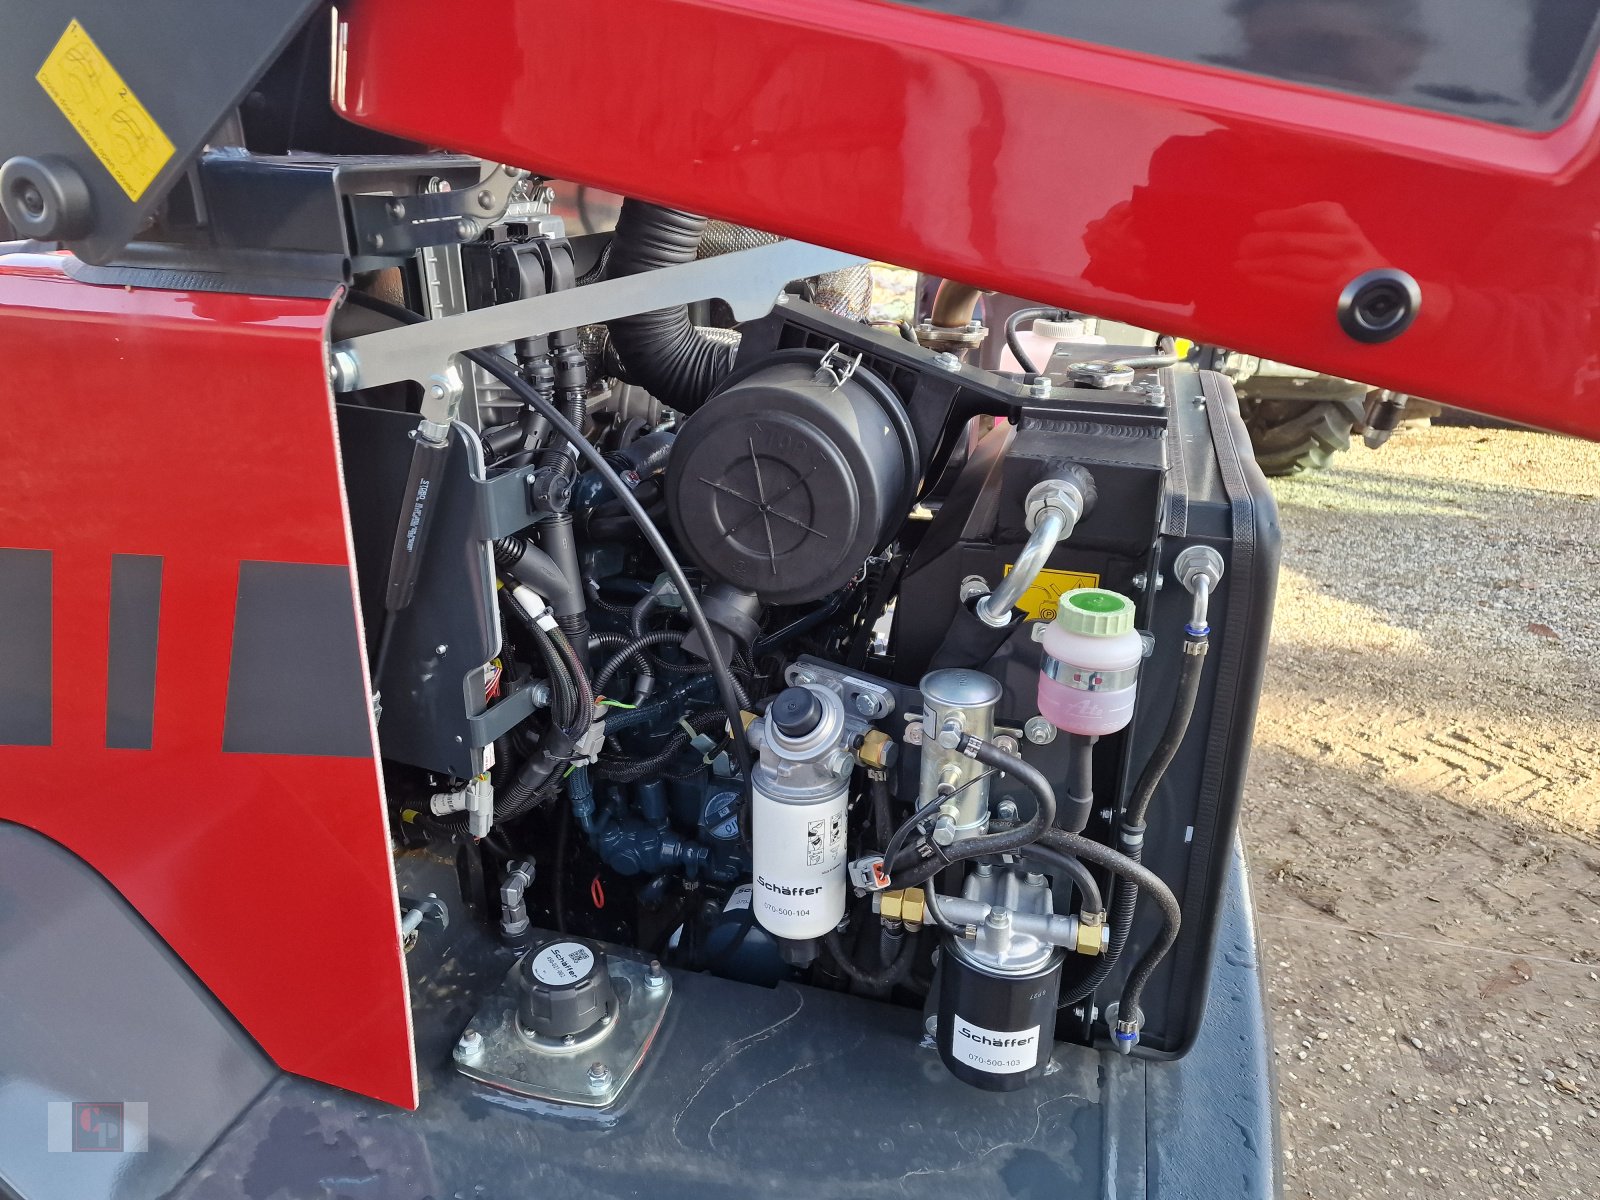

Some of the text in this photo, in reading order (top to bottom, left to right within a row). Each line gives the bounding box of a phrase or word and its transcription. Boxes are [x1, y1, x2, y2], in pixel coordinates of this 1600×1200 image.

[756, 875, 823, 896] Schäffer
[763, 902, 810, 917] 070-500-104
[551, 948, 578, 979] Schäffer
[958, 1027, 1035, 1048] Schäffer
[968, 1053, 1021, 1067] 070-500-103
